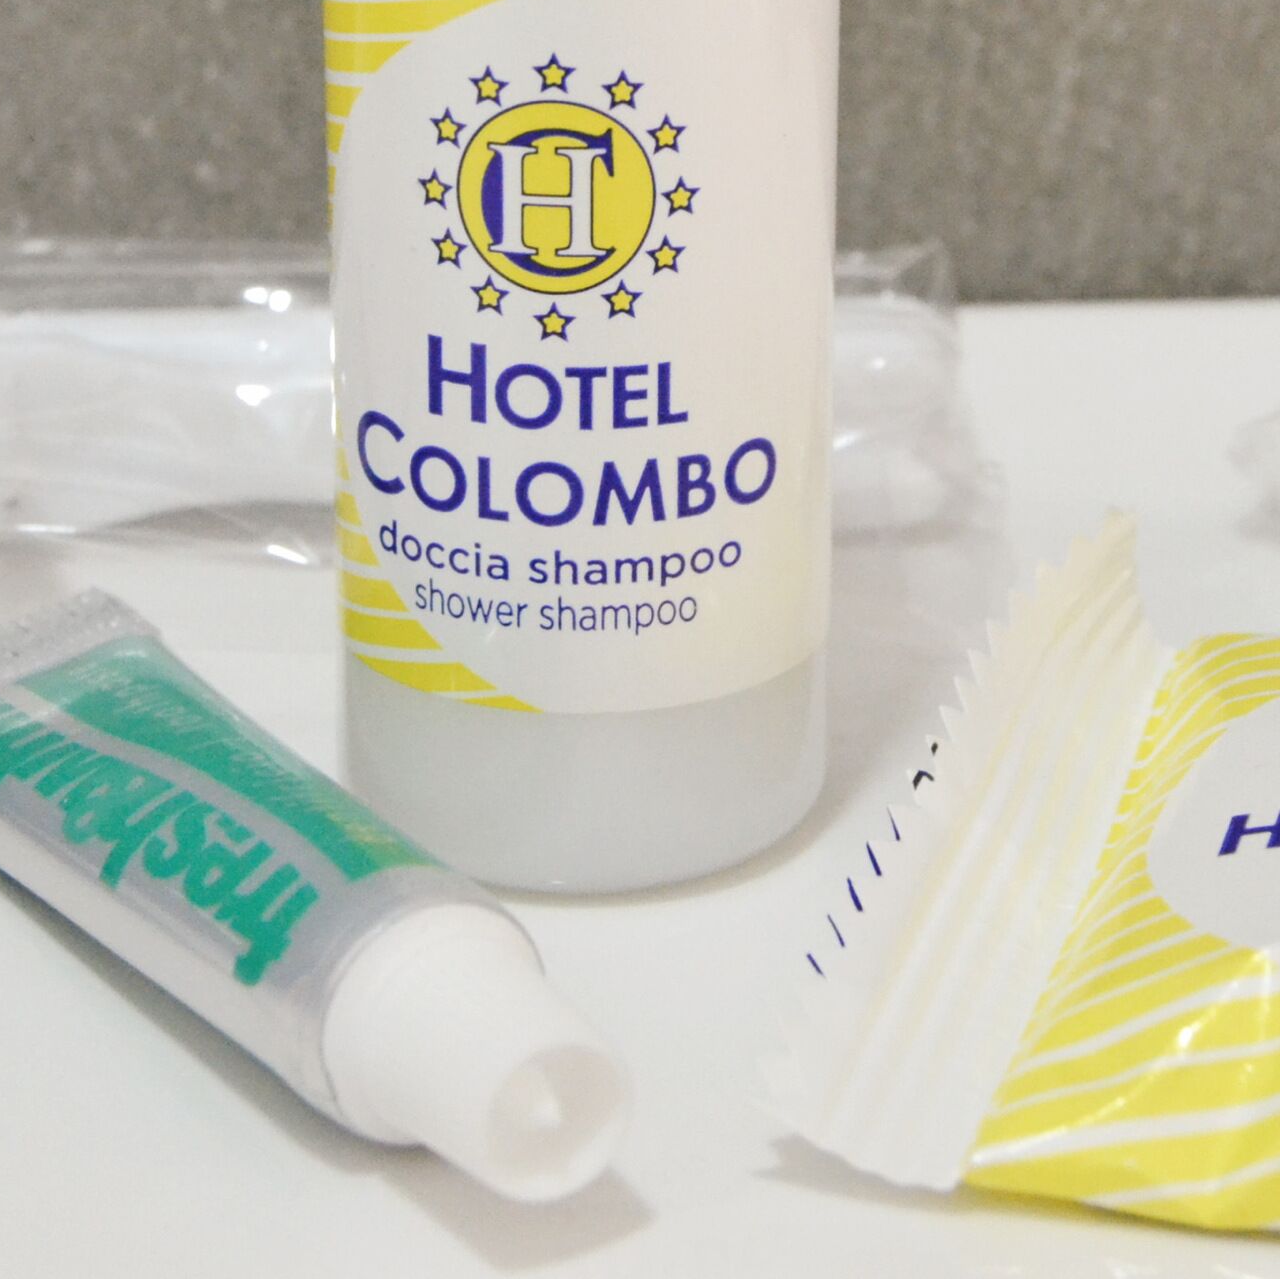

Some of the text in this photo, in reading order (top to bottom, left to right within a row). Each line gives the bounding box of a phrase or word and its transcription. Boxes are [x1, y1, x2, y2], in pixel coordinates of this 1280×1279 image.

[426, 333, 689, 431] HOTEL
[357, 409, 777, 527] COLOMBO
[379, 520, 742, 587] doccia shampoo
[415, 578, 698, 637] shower shampoo
